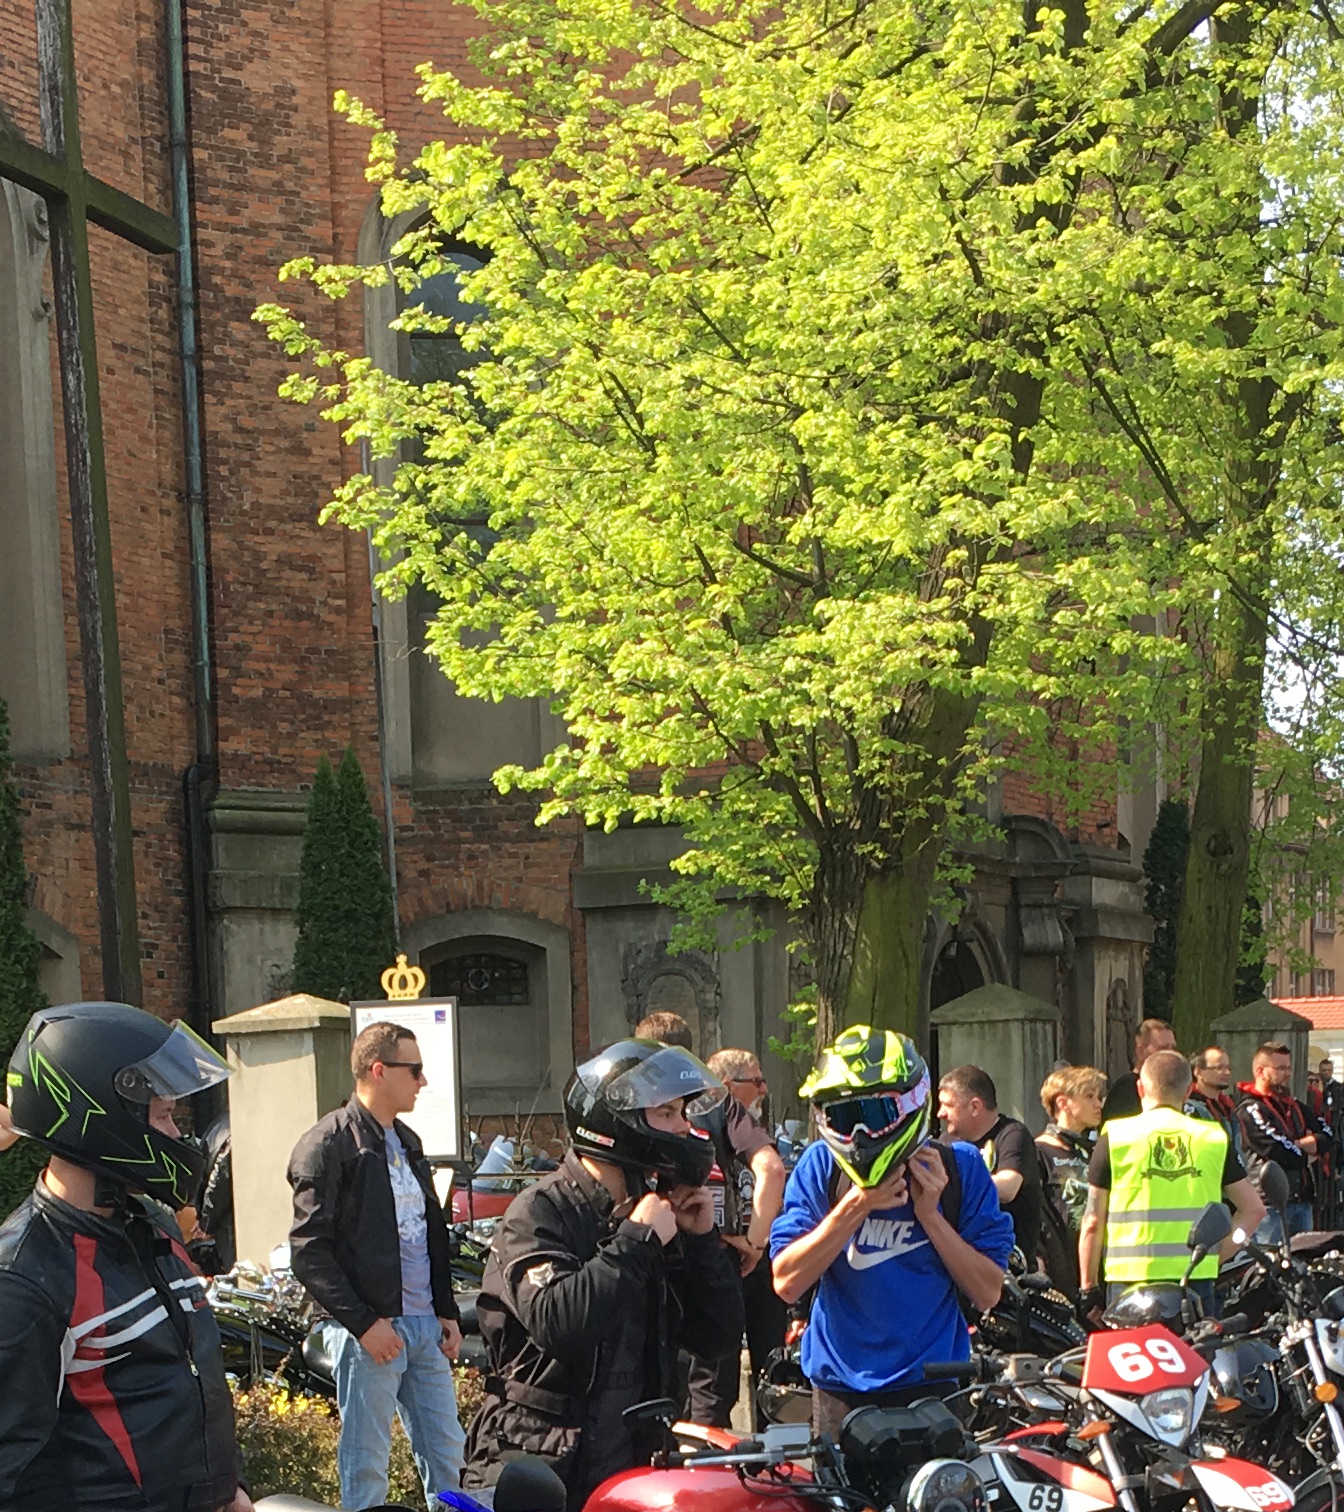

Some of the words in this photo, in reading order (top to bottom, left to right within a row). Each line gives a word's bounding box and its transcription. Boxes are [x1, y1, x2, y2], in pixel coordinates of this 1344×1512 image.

[857, 1217, 915, 1248] NIKE
[1107, 1338, 1186, 1382] 69
[1244, 1481, 1289, 1507] 69
